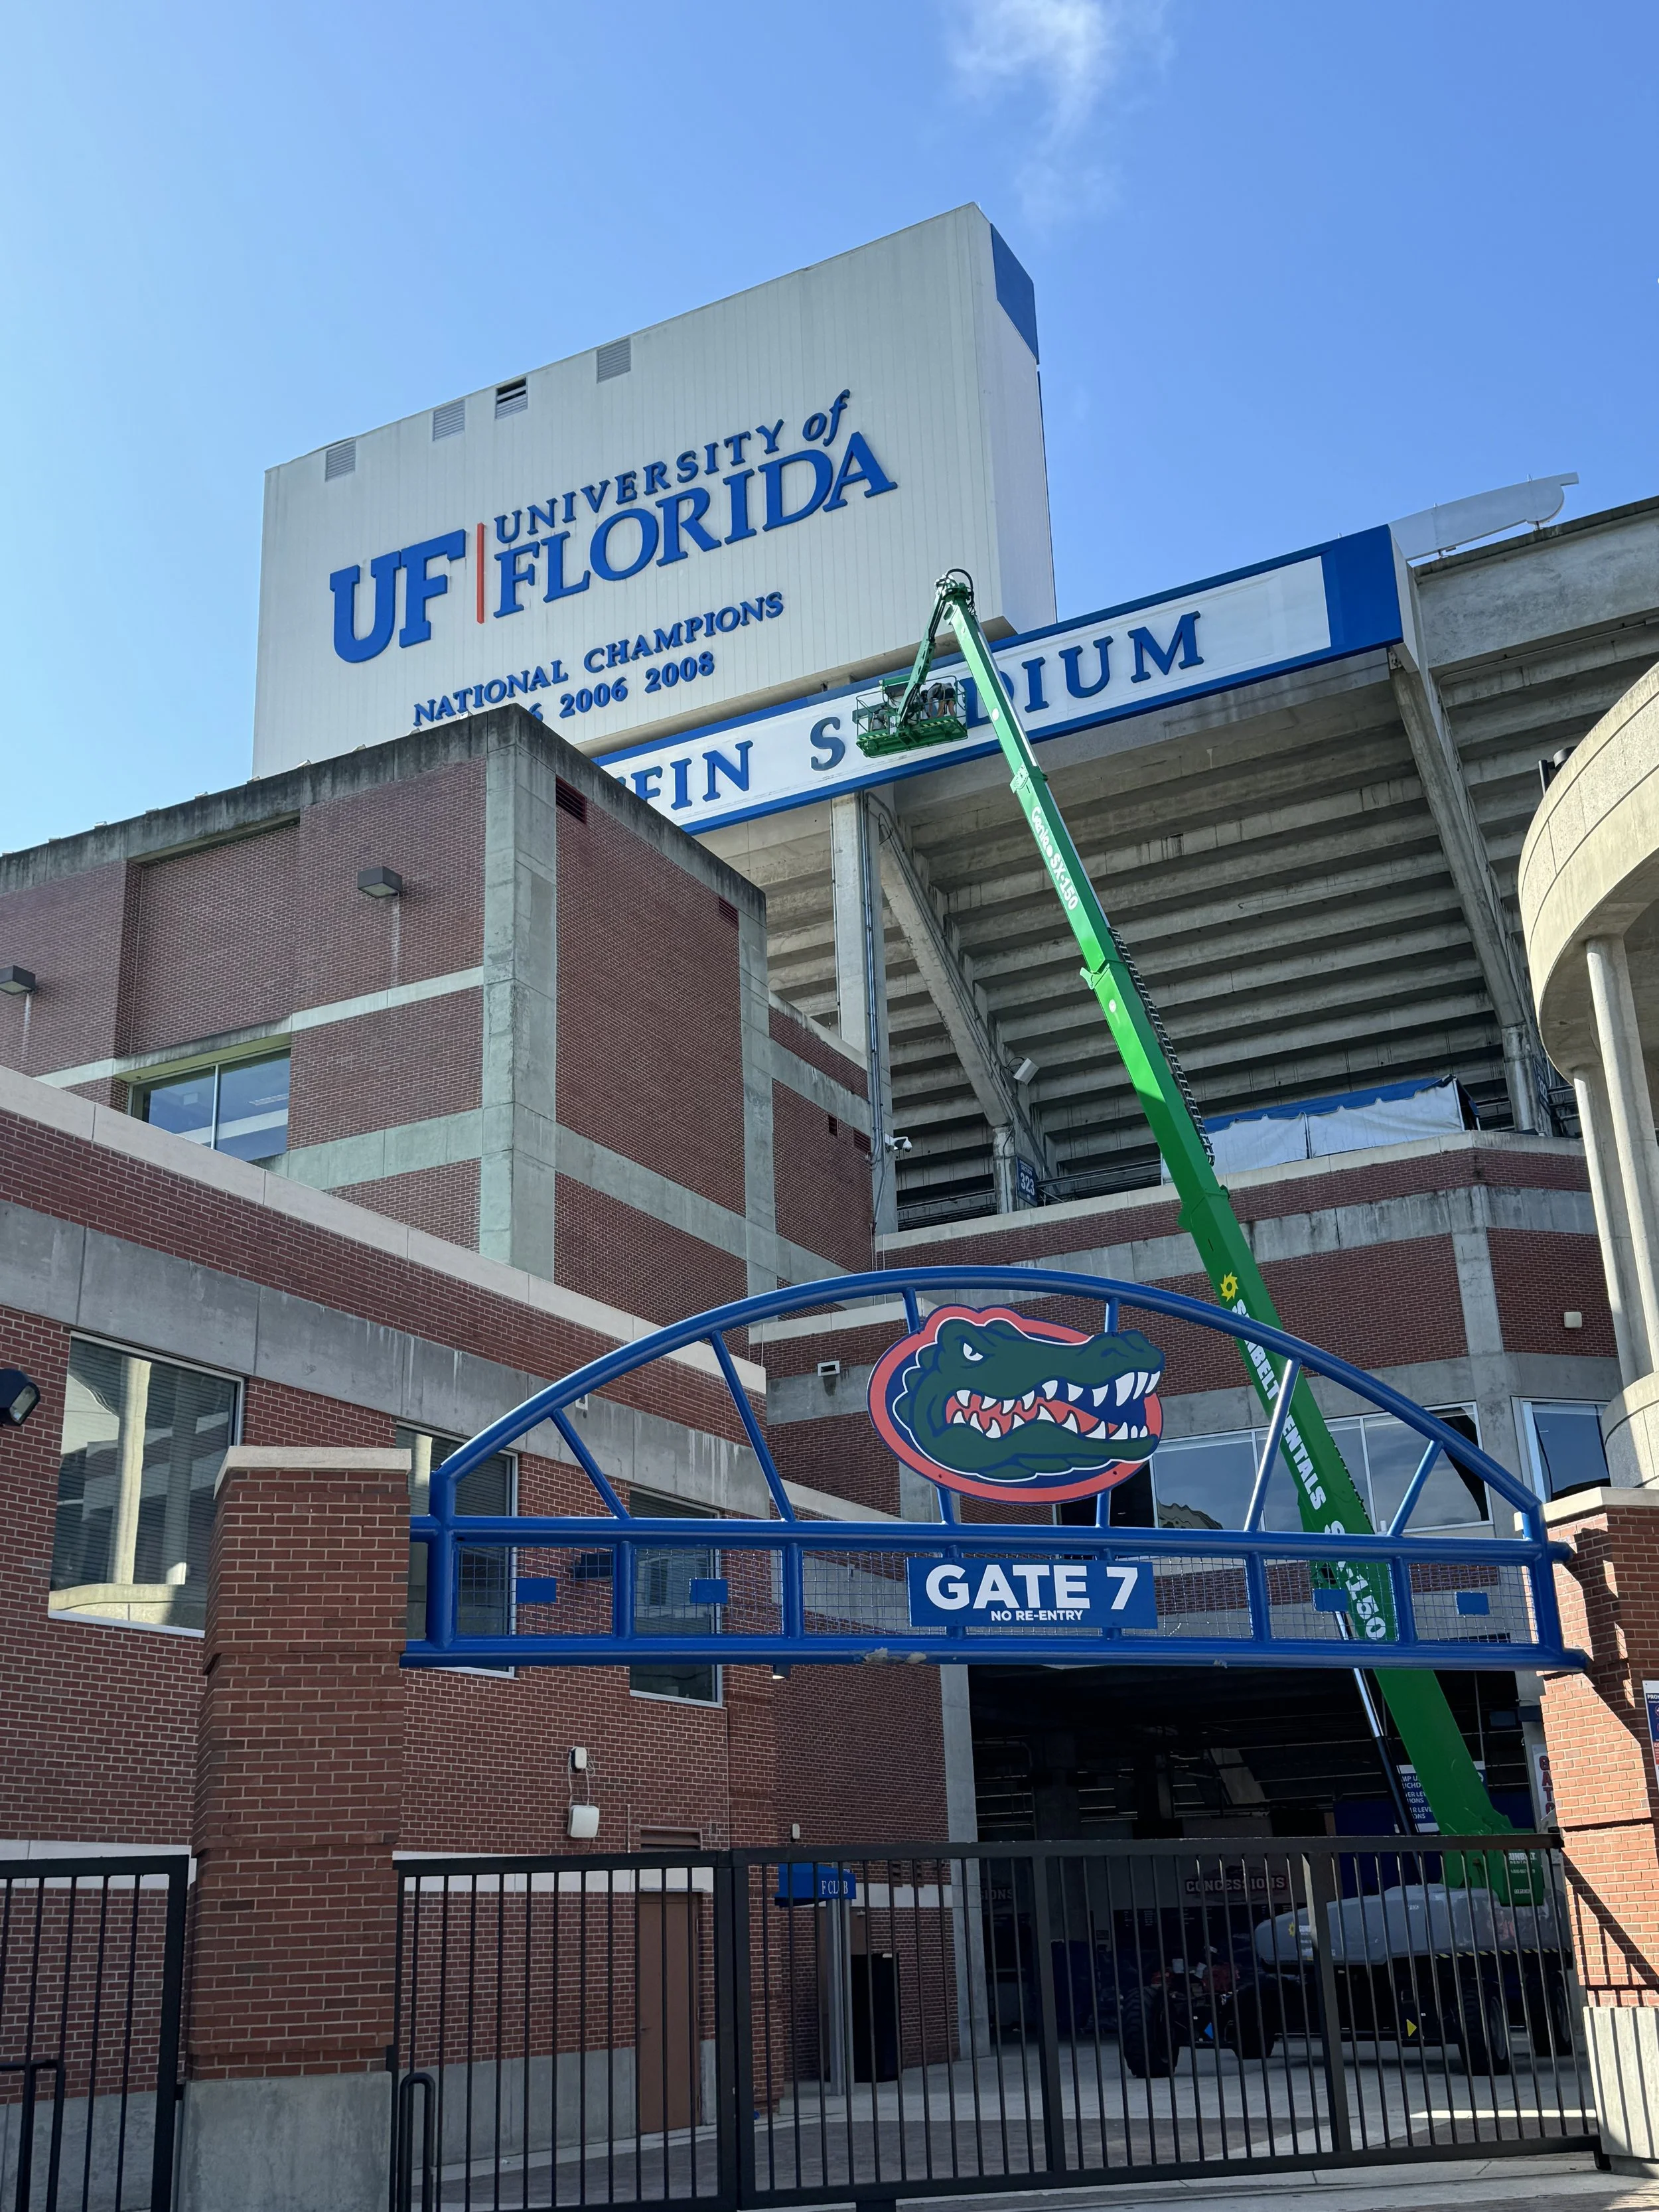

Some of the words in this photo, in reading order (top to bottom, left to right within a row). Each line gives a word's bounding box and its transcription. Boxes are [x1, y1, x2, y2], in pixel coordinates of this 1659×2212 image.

[494, 419, 784, 544] UNIVERSITY
[802, 389, 851, 446] of
[494, 431, 898, 619] FLORIDA
[330, 529, 467, 664] UF
[413, 660, 569, 726] NATIONAL
[584, 591, 784, 674] CHAMPIONS
[559, 676, 628, 719] 2006
[645, 651, 715, 694] 2008
[616, 740, 754, 810] FIN
[810, 610, 1204, 771] SDIUM
[1020, 1172, 1035, 1196] 323
[1282, 1412, 1327, 1510] ENTALS
[926, 1564, 1090, 1610] GATE
[1106, 1566, 1138, 1610] 7
[991, 1611, 1012, 1621] NO
[1016, 1610, 1083, 1621] RE-ENTRY
[822, 1880, 827, 1895] F
[828, 1880, 849, 1894] CLB
